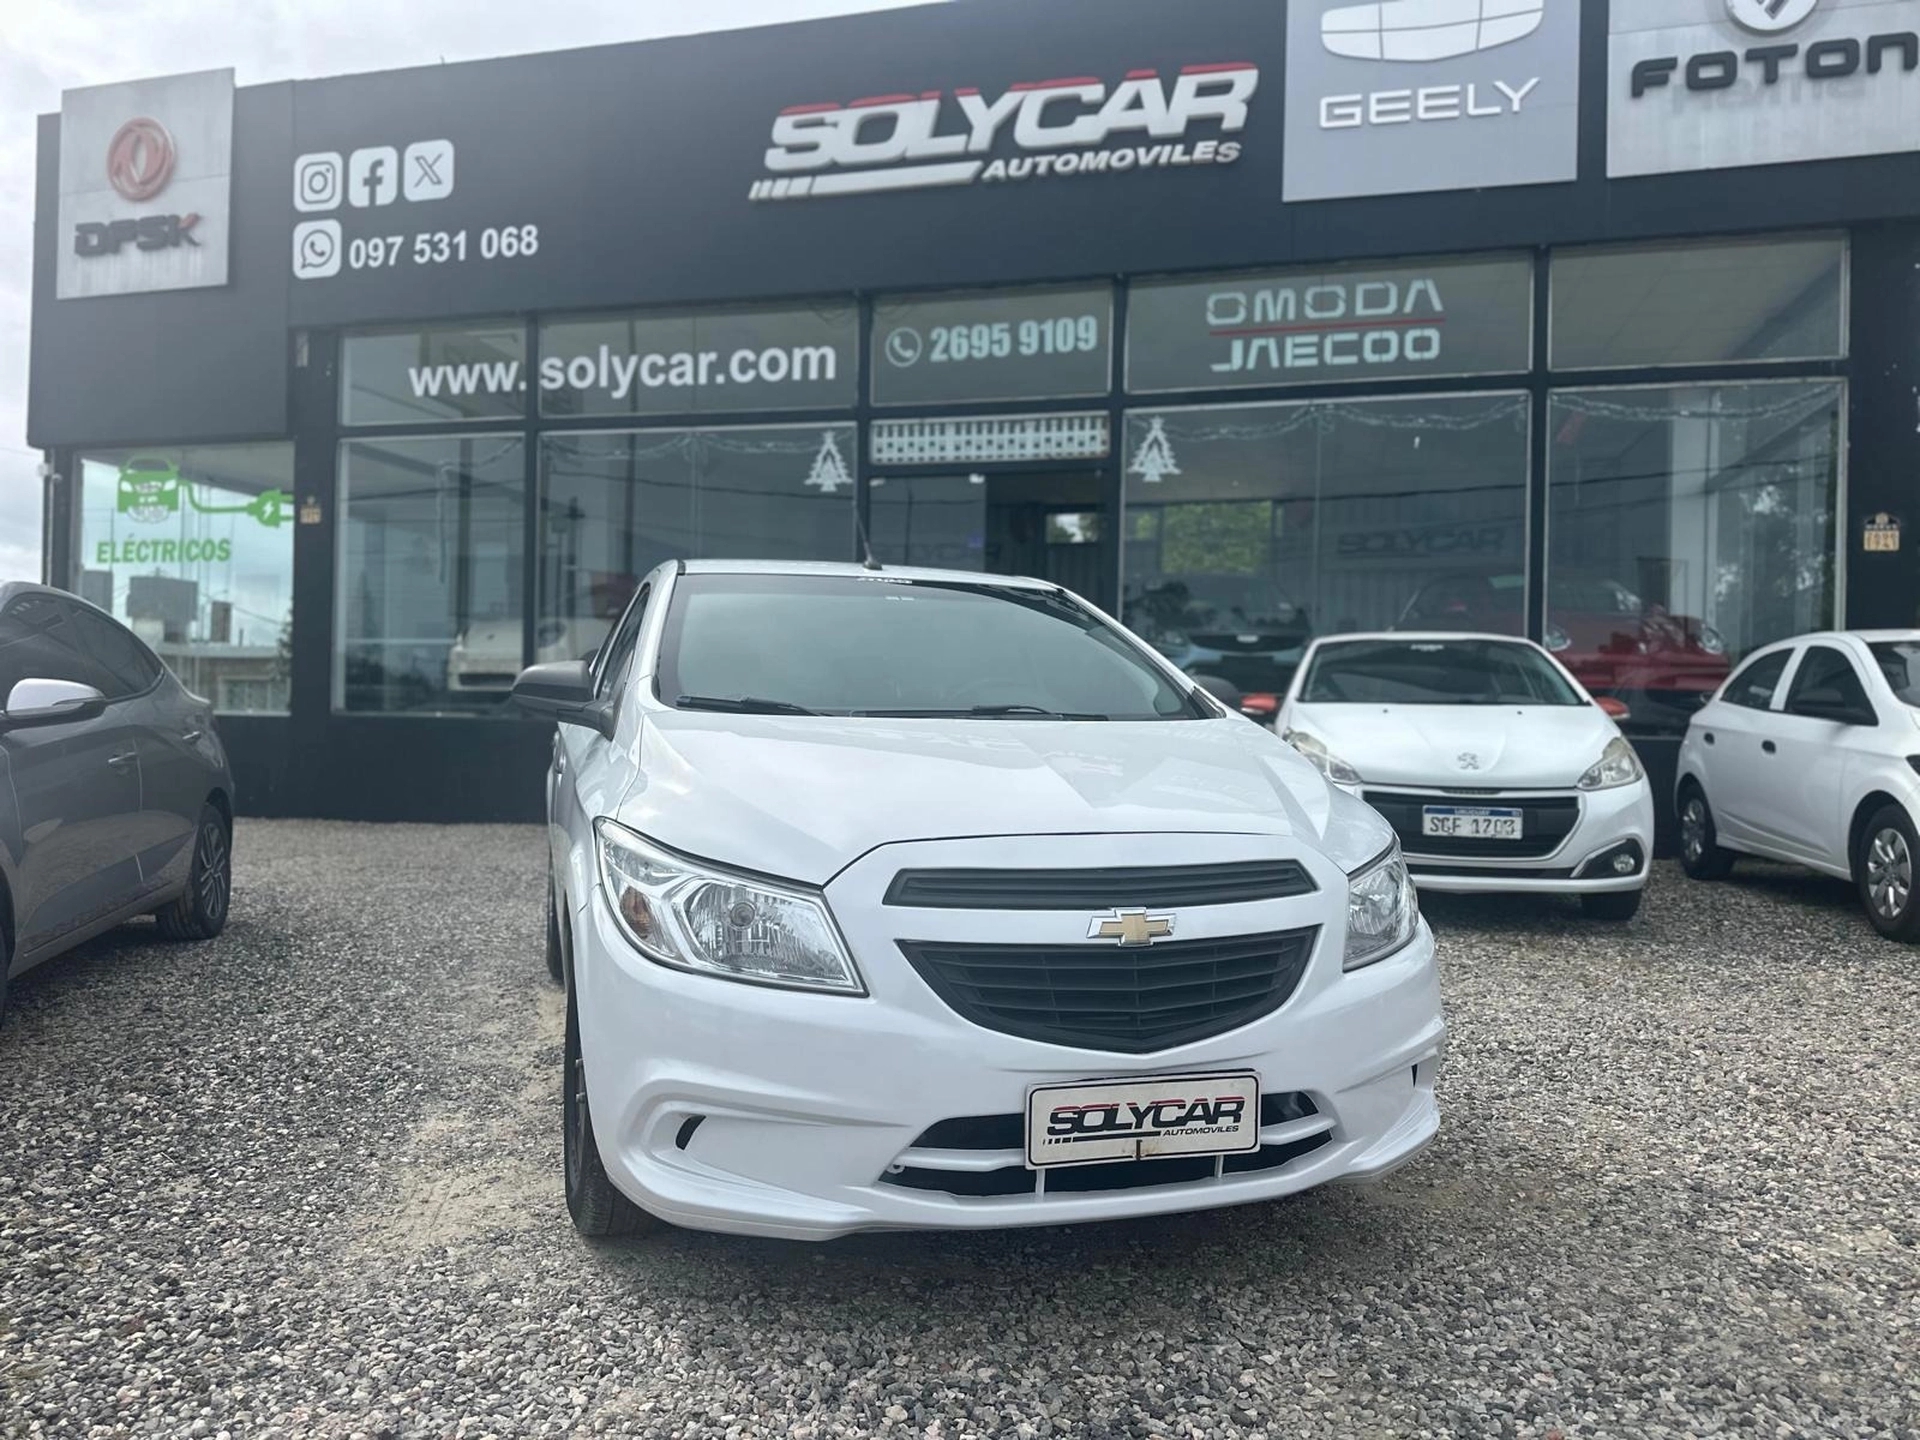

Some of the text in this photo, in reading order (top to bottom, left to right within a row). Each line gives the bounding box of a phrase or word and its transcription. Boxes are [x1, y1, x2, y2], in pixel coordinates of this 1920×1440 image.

[764, 62, 1259, 172] SOLYCAR
[1320, 77, 1540, 128] GEELY
[982, 141, 1242, 179] AUTOMOVILES
[349, 224, 539, 269] 097 531 068
[1206, 279, 1444, 326] OMODA
[929, 315, 1098, 362] 2695 9109
[1210, 328, 1441, 372] JAECOO
[96, 532, 232, 564] ELÉCTRICOS
[1047, 1096, 1245, 1136] SOLYCAR
[1163, 1125, 1240, 1137] AUTOMOVILES
